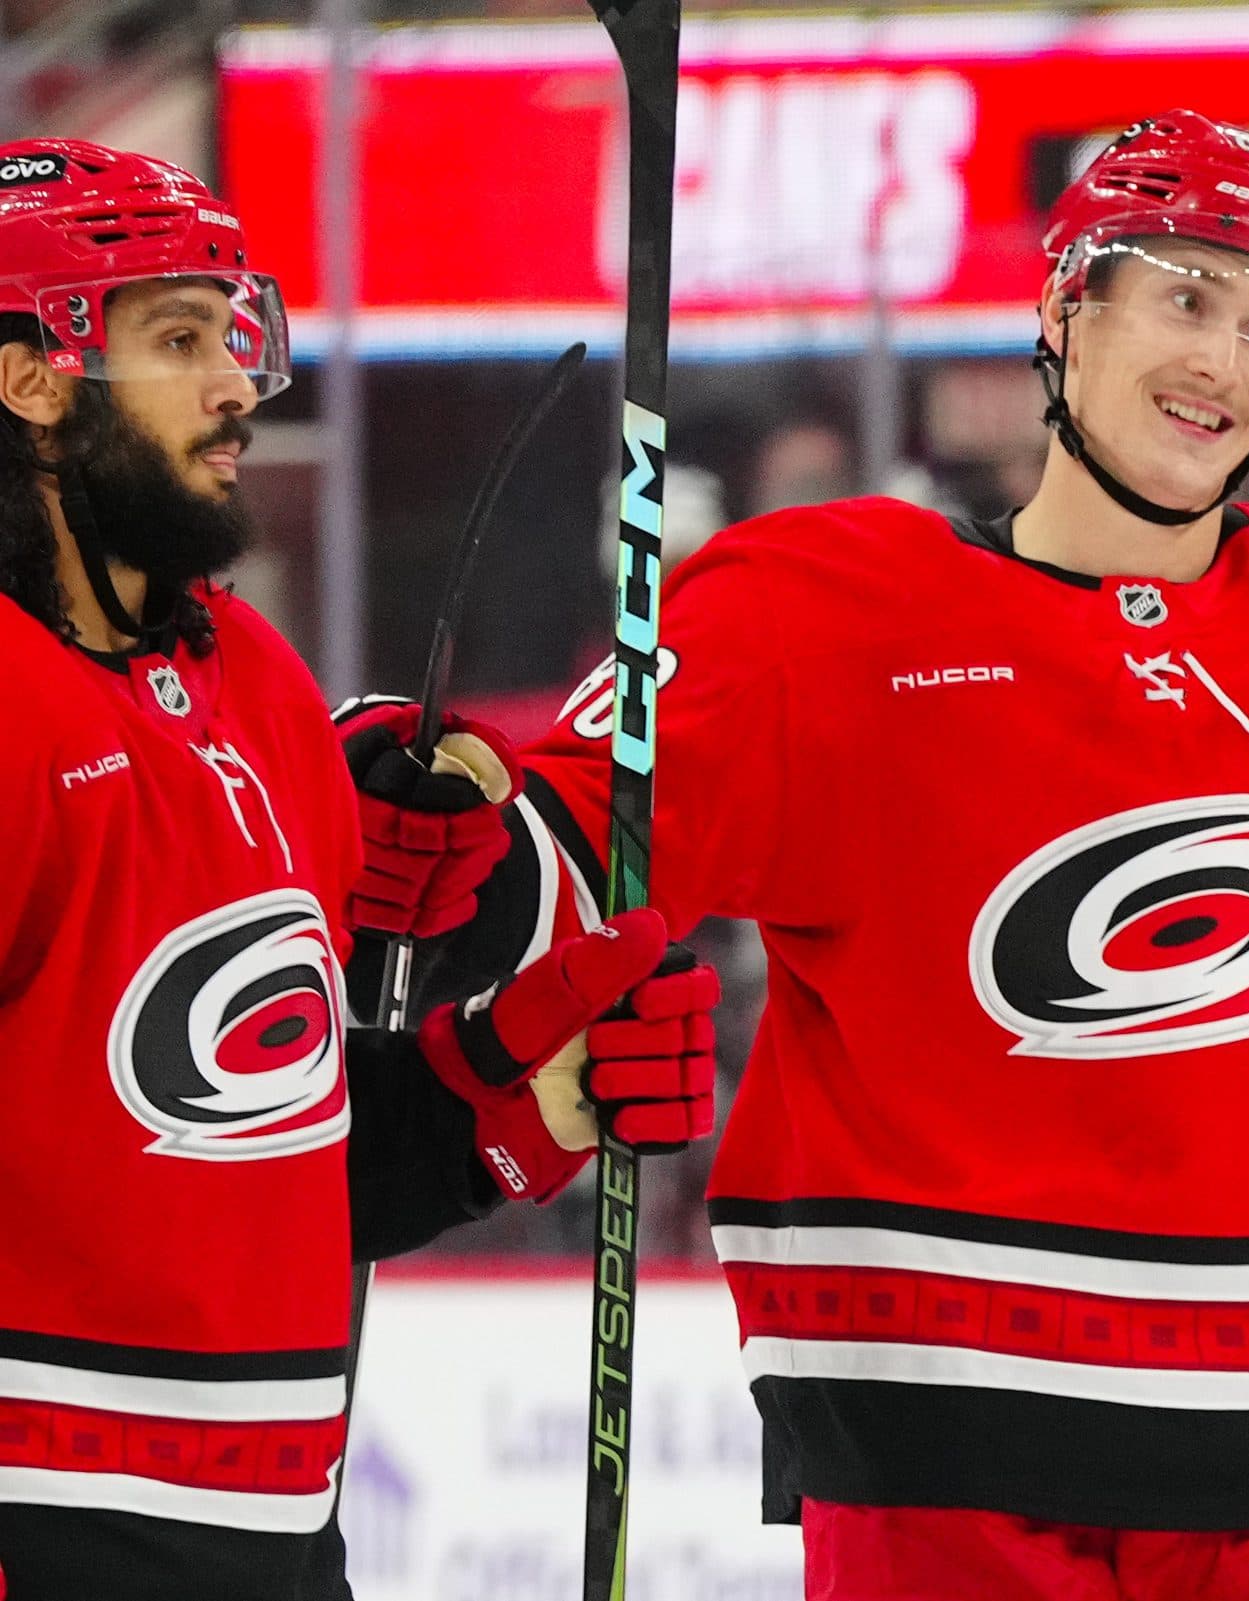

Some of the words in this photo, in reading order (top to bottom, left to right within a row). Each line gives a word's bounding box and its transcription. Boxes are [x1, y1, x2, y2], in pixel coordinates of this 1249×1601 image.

[612, 399, 666, 777] CCM
[891, 666, 1015, 692] NUCOR
[61, 751, 131, 790] NUCO
[594, 1134, 635, 1497] JETSPEE
